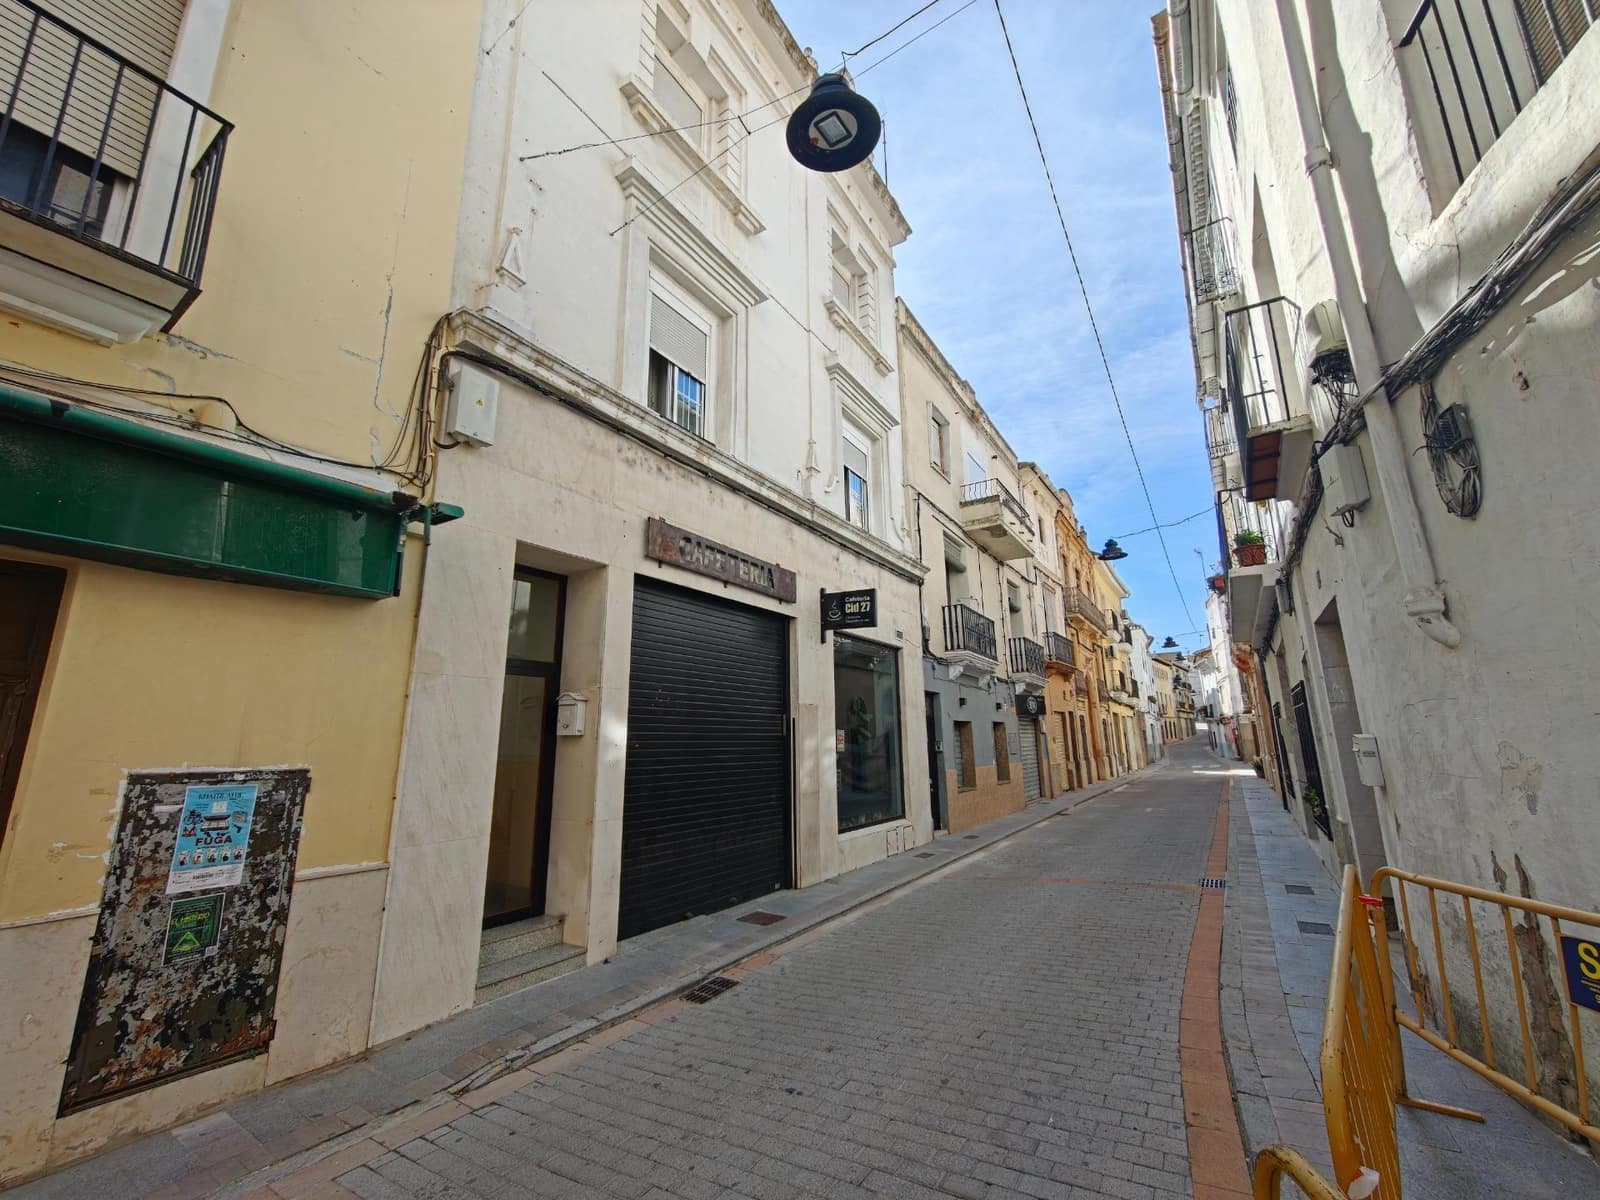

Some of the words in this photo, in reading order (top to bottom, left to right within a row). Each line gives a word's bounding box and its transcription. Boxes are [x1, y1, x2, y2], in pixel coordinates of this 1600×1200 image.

[679, 537, 775, 589] CAFETERIA
[845, 602, 859, 613] Cid
[860, 602, 870, 612] 27
[195, 835, 233, 846] FUGA
